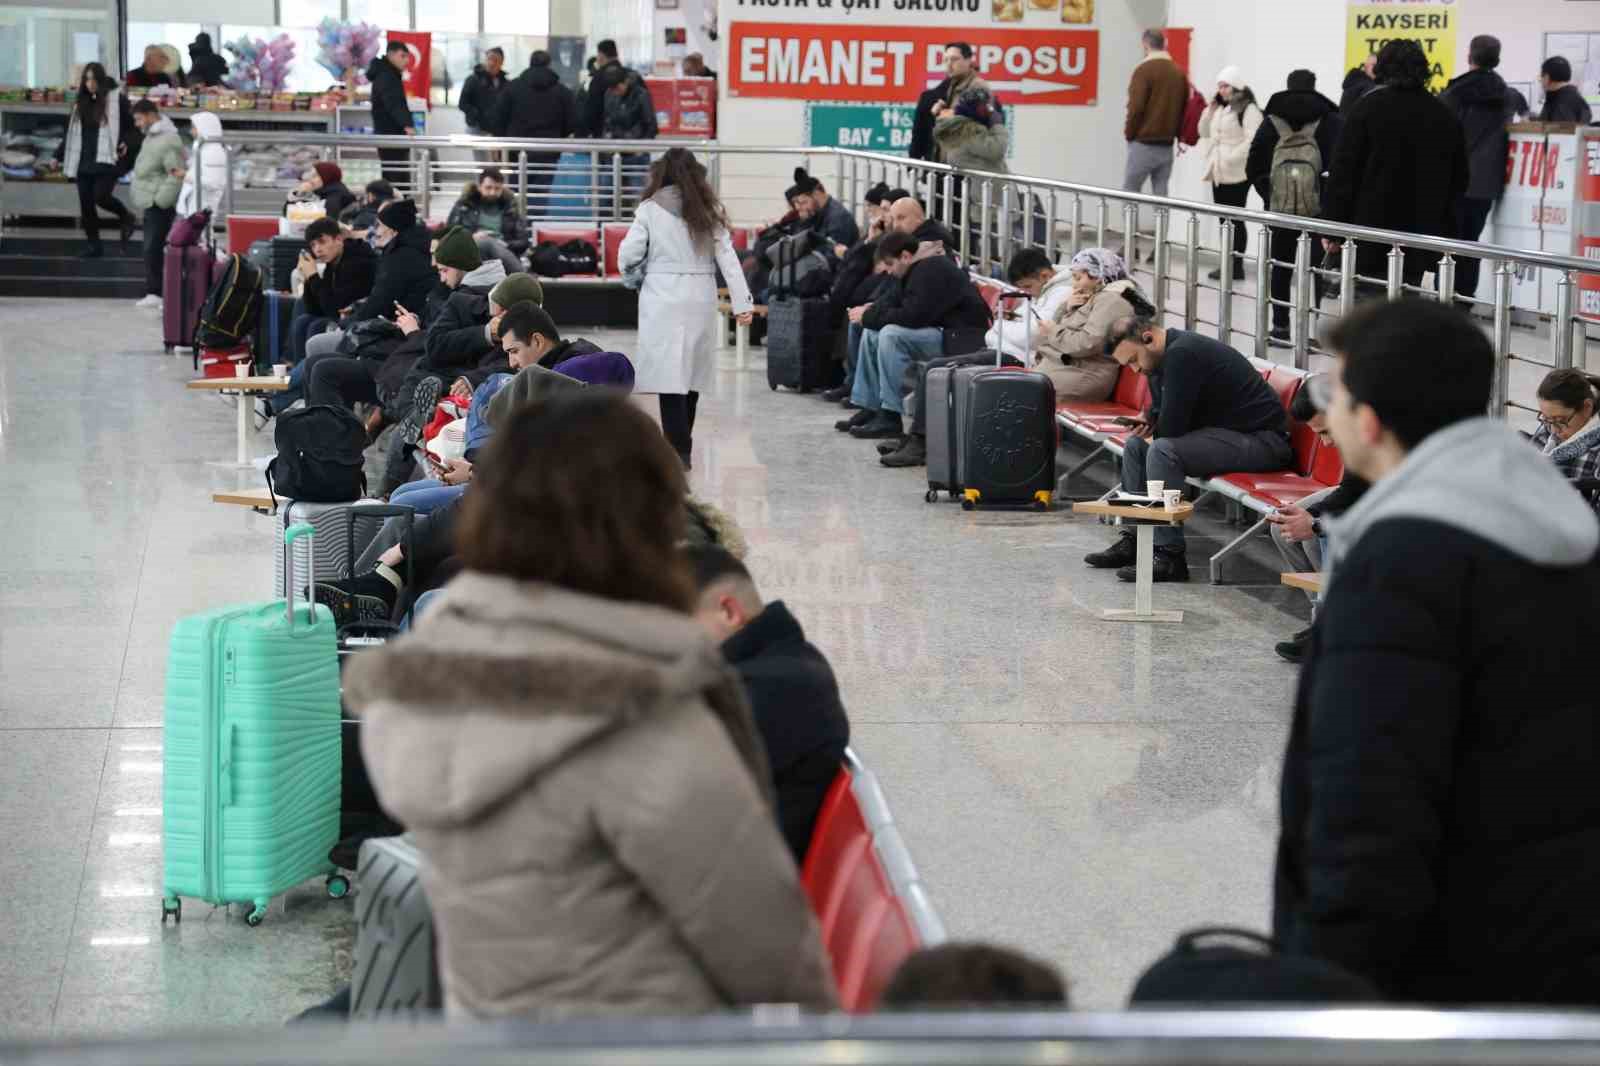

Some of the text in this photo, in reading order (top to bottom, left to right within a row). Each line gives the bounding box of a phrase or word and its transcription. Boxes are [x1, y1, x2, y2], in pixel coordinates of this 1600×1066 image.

[894, 0, 980, 12] SALONU
[1356, 10, 1448, 29] KAYSERİ
[741, 37, 1086, 87] EMANET DPOSU
[838, 127, 873, 146] BAY
